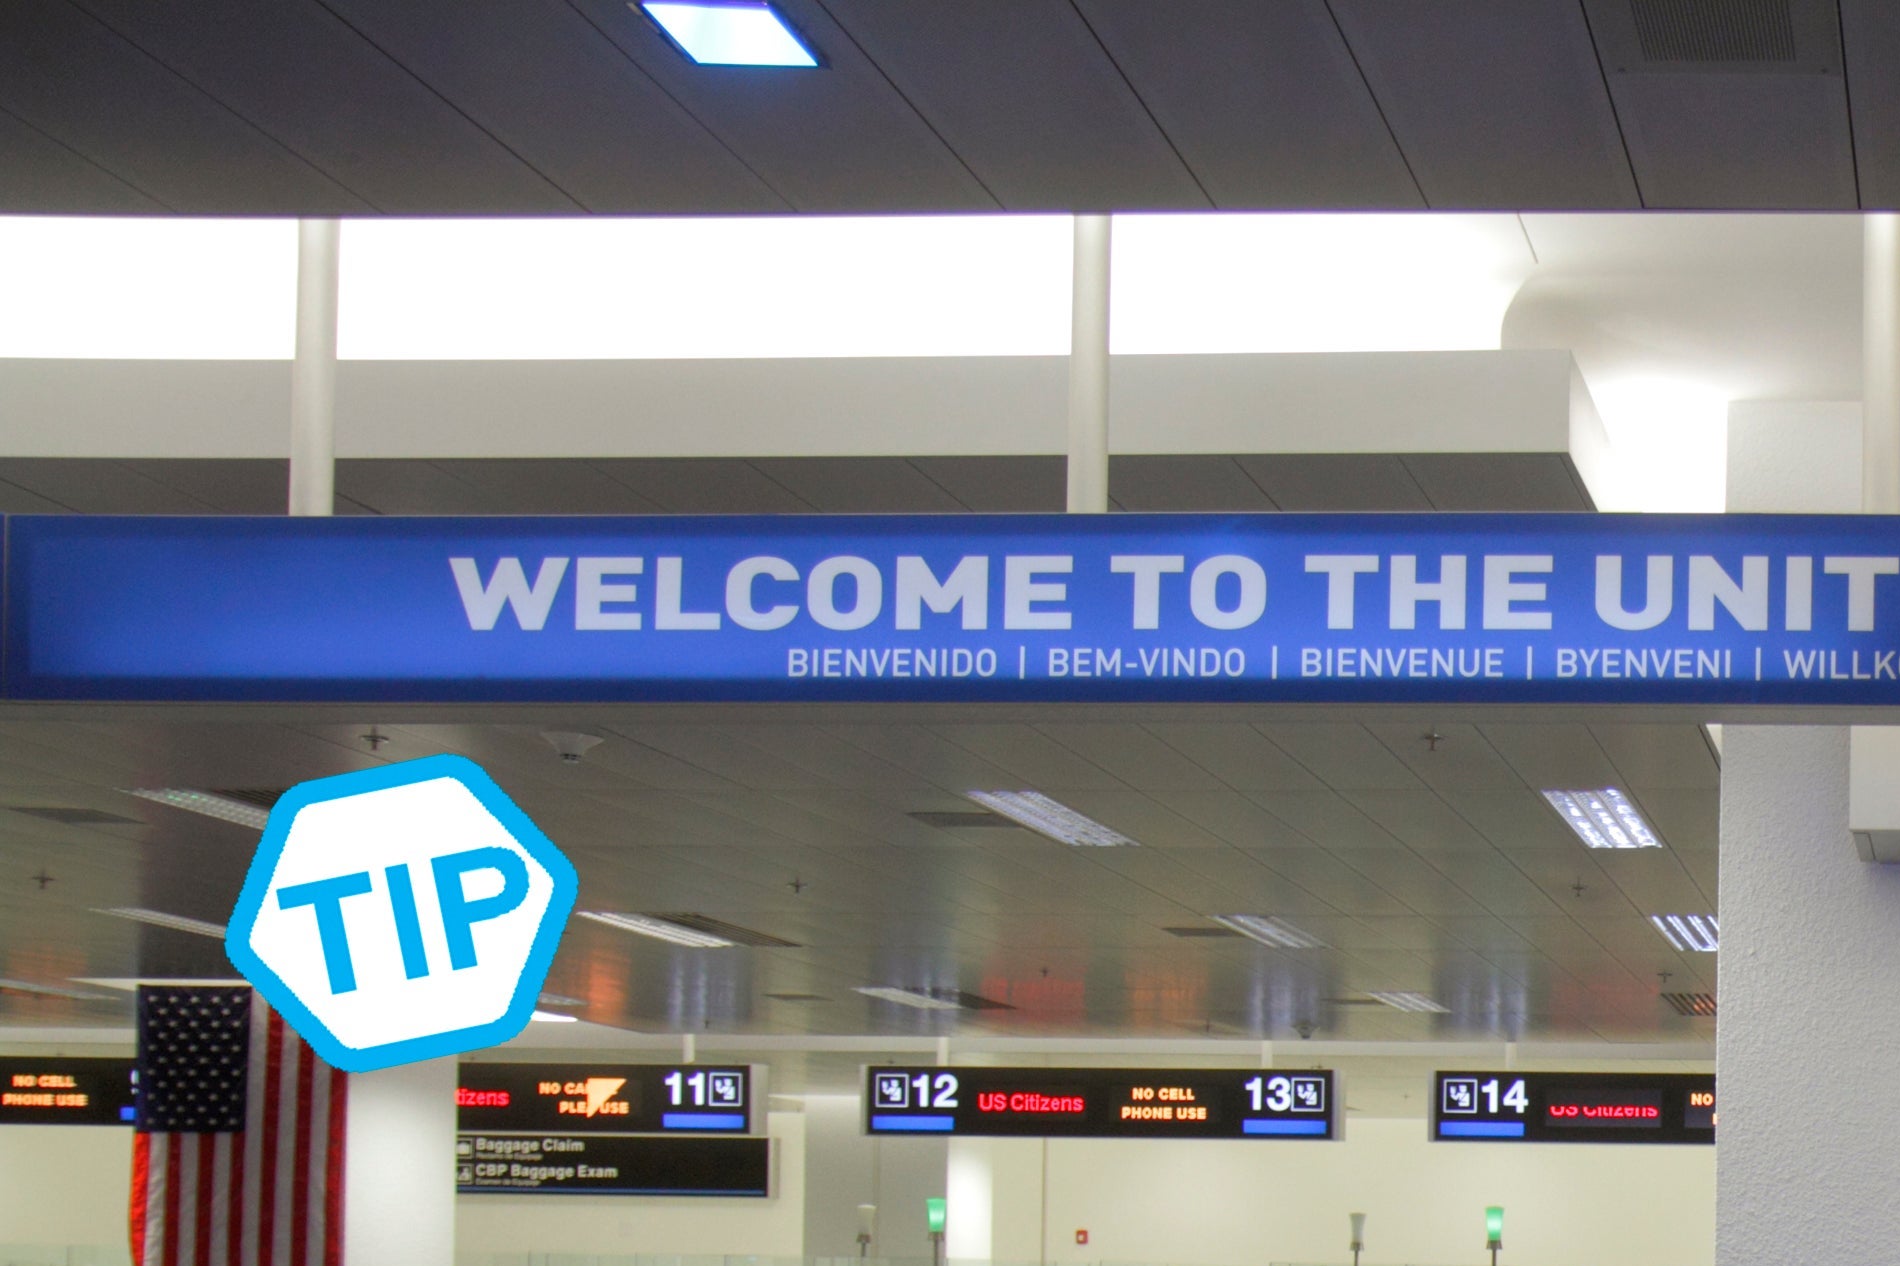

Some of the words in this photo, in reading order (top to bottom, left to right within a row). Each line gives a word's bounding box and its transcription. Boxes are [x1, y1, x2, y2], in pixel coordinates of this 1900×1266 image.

[448, 555, 1073, 631] WELCOME
[1110, 554, 1267, 631] TO
[1304, 554, 1553, 630] THE
[787, 648, 997, 678] BIENVENIDO
[1048, 648, 1246, 678] BEM-VINDO
[1301, 648, 1504, 679] BIENVENUE
[1556, 648, 1731, 679] BYENVENI
[11, 1074, 37, 1088] NO
[539, 1082, 562, 1095] NO
[664, 1072, 705, 1107] 11
[912, 1073, 959, 1108] 12
[55, 1093, 89, 1107] USE
[455, 1088, 510, 1107] tizens
[978, 1093, 1007, 1112] US
[1010, 1092, 1084, 1113] Citizens
[1132, 1087, 1155, 1100] NO
[1158, 1088, 1195, 1101] CELL
[1245, 1076, 1291, 1112] 13
[1481, 1079, 1529, 1114] 14
[1690, 1092, 1714, 1106] NO
[1121, 1106, 1172, 1120] PHONE
[1176, 1107, 1207, 1121] USE
[475, 1137, 540, 1154] Baggage
[542, 1138, 586, 1152] Claim
[475, 1162, 508, 1177] CBP
[510, 1163, 576, 1181] Baggage
[577, 1164, 619, 1178] Exam
